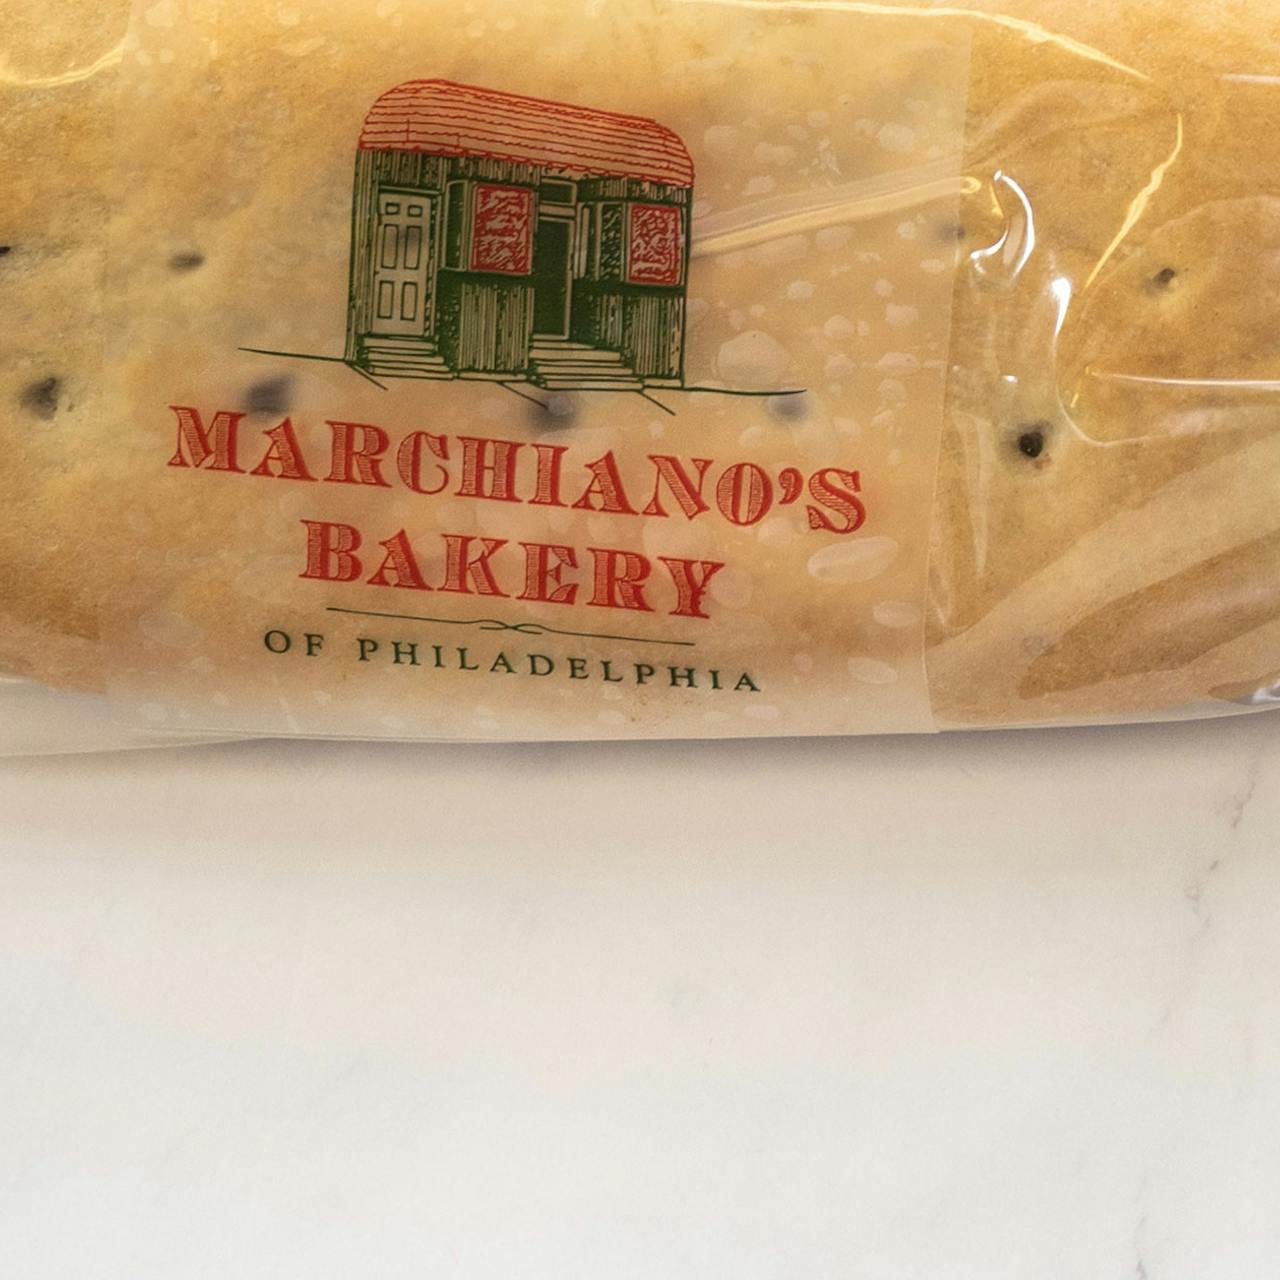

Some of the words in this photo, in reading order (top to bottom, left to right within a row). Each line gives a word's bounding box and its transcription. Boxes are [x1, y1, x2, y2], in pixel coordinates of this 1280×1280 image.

[167, 405, 866, 535] MARCHIANO'S
[299, 519, 726, 619] BAKERY
[264, 630, 326, 657] OF
[357, 638, 762, 693] PHILADELPHIA
